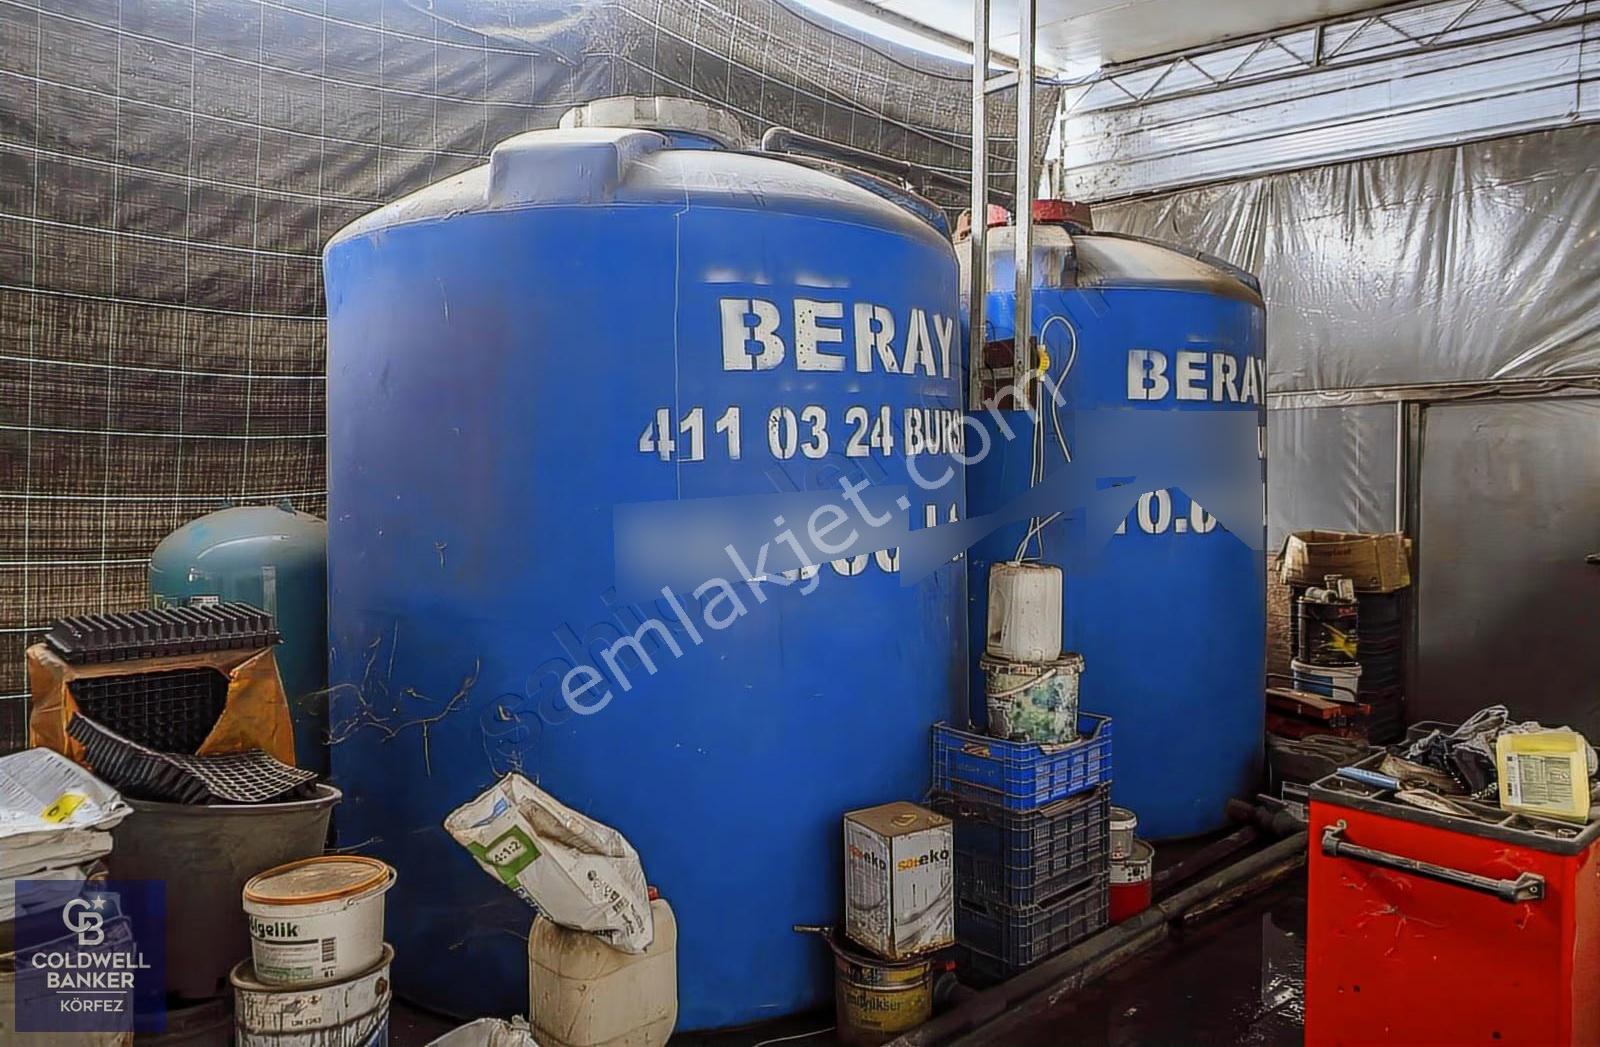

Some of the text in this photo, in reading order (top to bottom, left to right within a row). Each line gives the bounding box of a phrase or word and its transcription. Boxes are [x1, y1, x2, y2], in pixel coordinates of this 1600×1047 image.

[719, 298, 953, 378] BERAY
[639, 405, 964, 462] 411 03 24 BURS
